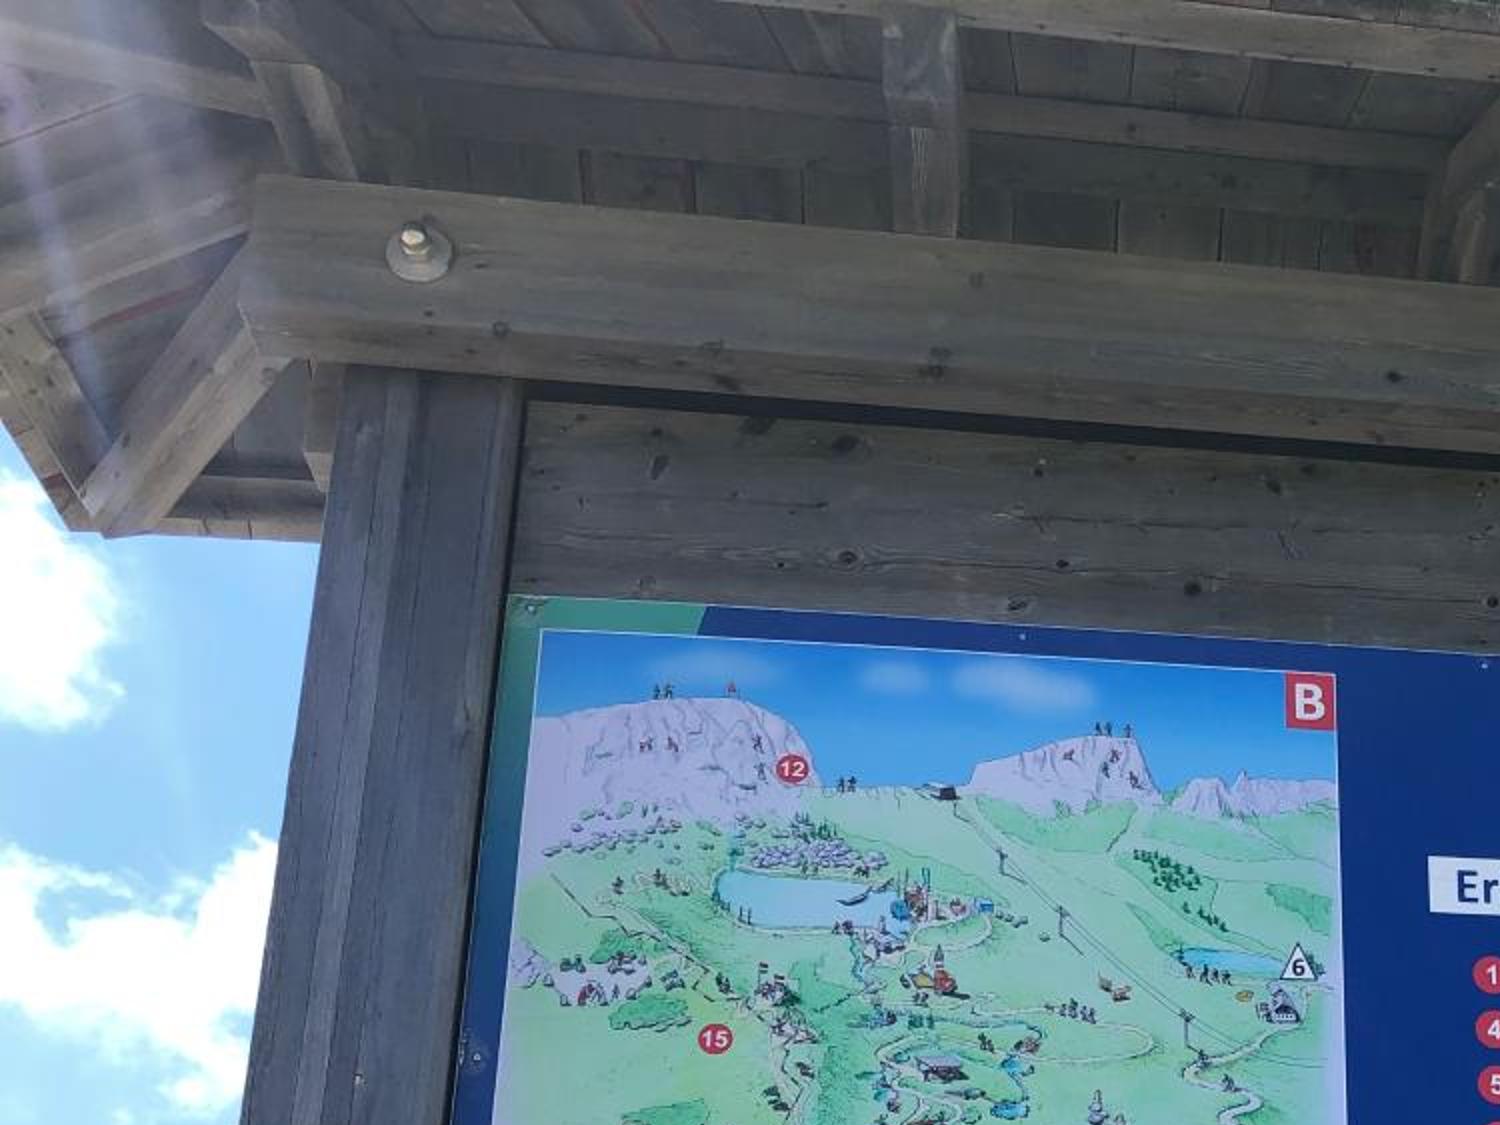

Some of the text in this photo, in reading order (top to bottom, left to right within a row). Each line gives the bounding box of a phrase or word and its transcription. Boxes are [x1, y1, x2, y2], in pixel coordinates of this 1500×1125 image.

[1294, 682, 1326, 721] B
[781, 761, 805, 777] 12
[1291, 959, 1304, 976] 6
[1486, 964, 1497, 985] 1
[702, 1030, 728, 1048] 15
